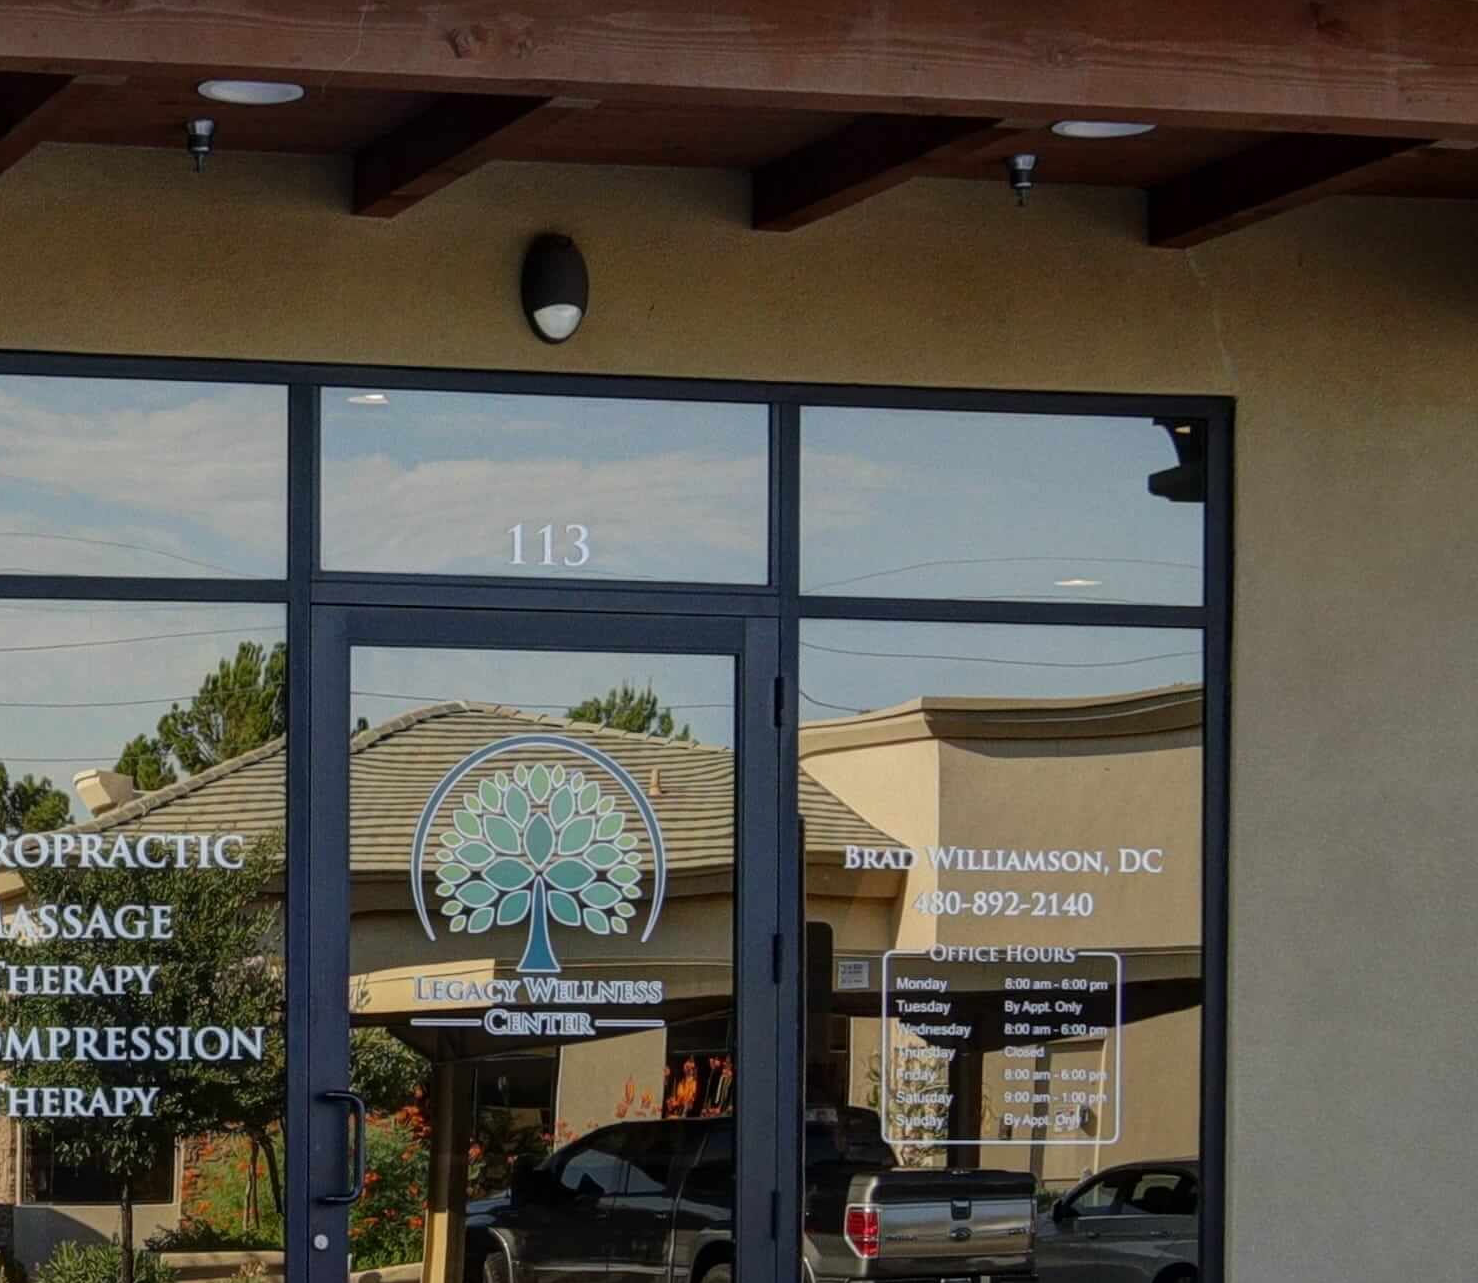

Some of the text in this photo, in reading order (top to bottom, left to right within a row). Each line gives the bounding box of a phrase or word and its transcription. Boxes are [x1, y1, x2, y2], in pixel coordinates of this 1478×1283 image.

[507, 523, 590, 566] 113
[844, 845, 917, 869] BRAD
[1118, 848, 1163, 874] DC
[913, 891, 1093, 918] 480-892-2140
[929, 944, 1076, 963] OFFICE HOURS
[413, 976, 663, 1004] LEGACY WELLNESS
[896, 977, 948, 993] Monday
[1004, 978, 1030, 990] 8:00
[1032, 980, 1051, 990] am
[1061, 978, 1086, 990] 6:00
[896, 1000, 951, 1015] Tuesday
[1004, 1001, 1020, 1015] By
[1055, 1001, 1083, 1015] Only
[484, 1009, 596, 1035] CENTER
[896, 1023, 972, 1038] Wednesday
[1032, 1026, 1051, 1035] am
[1004, 1047, 1045, 1058] Closed
[1032, 1072, 1051, 1080] am
[896, 1091, 954, 1106] Saturday
[1032, 1094, 1051, 1103] am
[896, 1115, 944, 1129] Sunday
[1004, 1115, 1021, 1128] By
